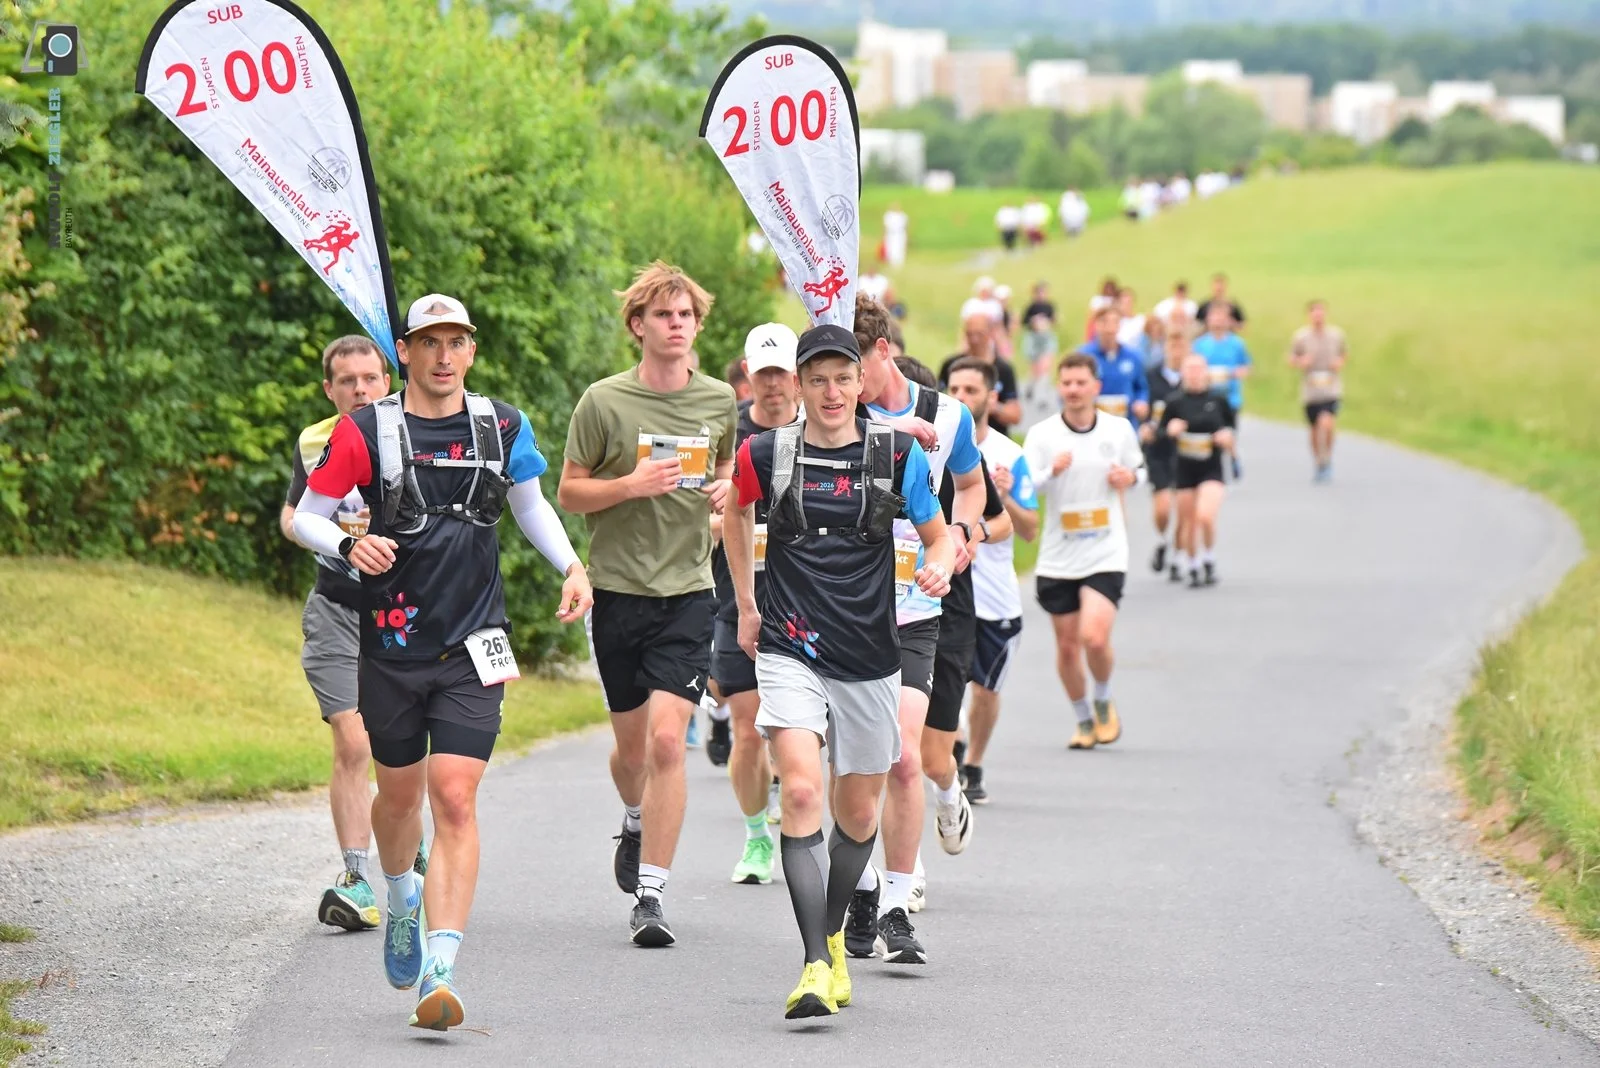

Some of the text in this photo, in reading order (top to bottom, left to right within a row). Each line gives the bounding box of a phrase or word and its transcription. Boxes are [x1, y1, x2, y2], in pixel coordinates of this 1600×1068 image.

[207, 4, 243, 25] SUB
[200, 56, 220, 109] STUNDEN
[223, 41, 298, 103] 00
[294, 35, 313, 89] MINUTEN
[765, 53, 794, 70] SUB
[164, 62, 208, 118] 2
[829, 86, 838, 138] MINUTEN
[723, 105, 749, 158] 2
[753, 100, 761, 151] STUNDEN
[770, 89, 827, 147] 00
[235, 148, 249, 164] DER
[248, 163, 265, 180] LAUF
[278, 195, 291, 208] DIE
[289, 208, 311, 229] SINNE
[241, 137, 320, 221] Mainauenlauf
[762, 190, 773, 204] DER
[771, 204, 784, 222] LAUF
[791, 237, 802, 249] DIE
[799, 250, 816, 273] SINNE
[769, 180, 823, 267] Mainauenlauf
